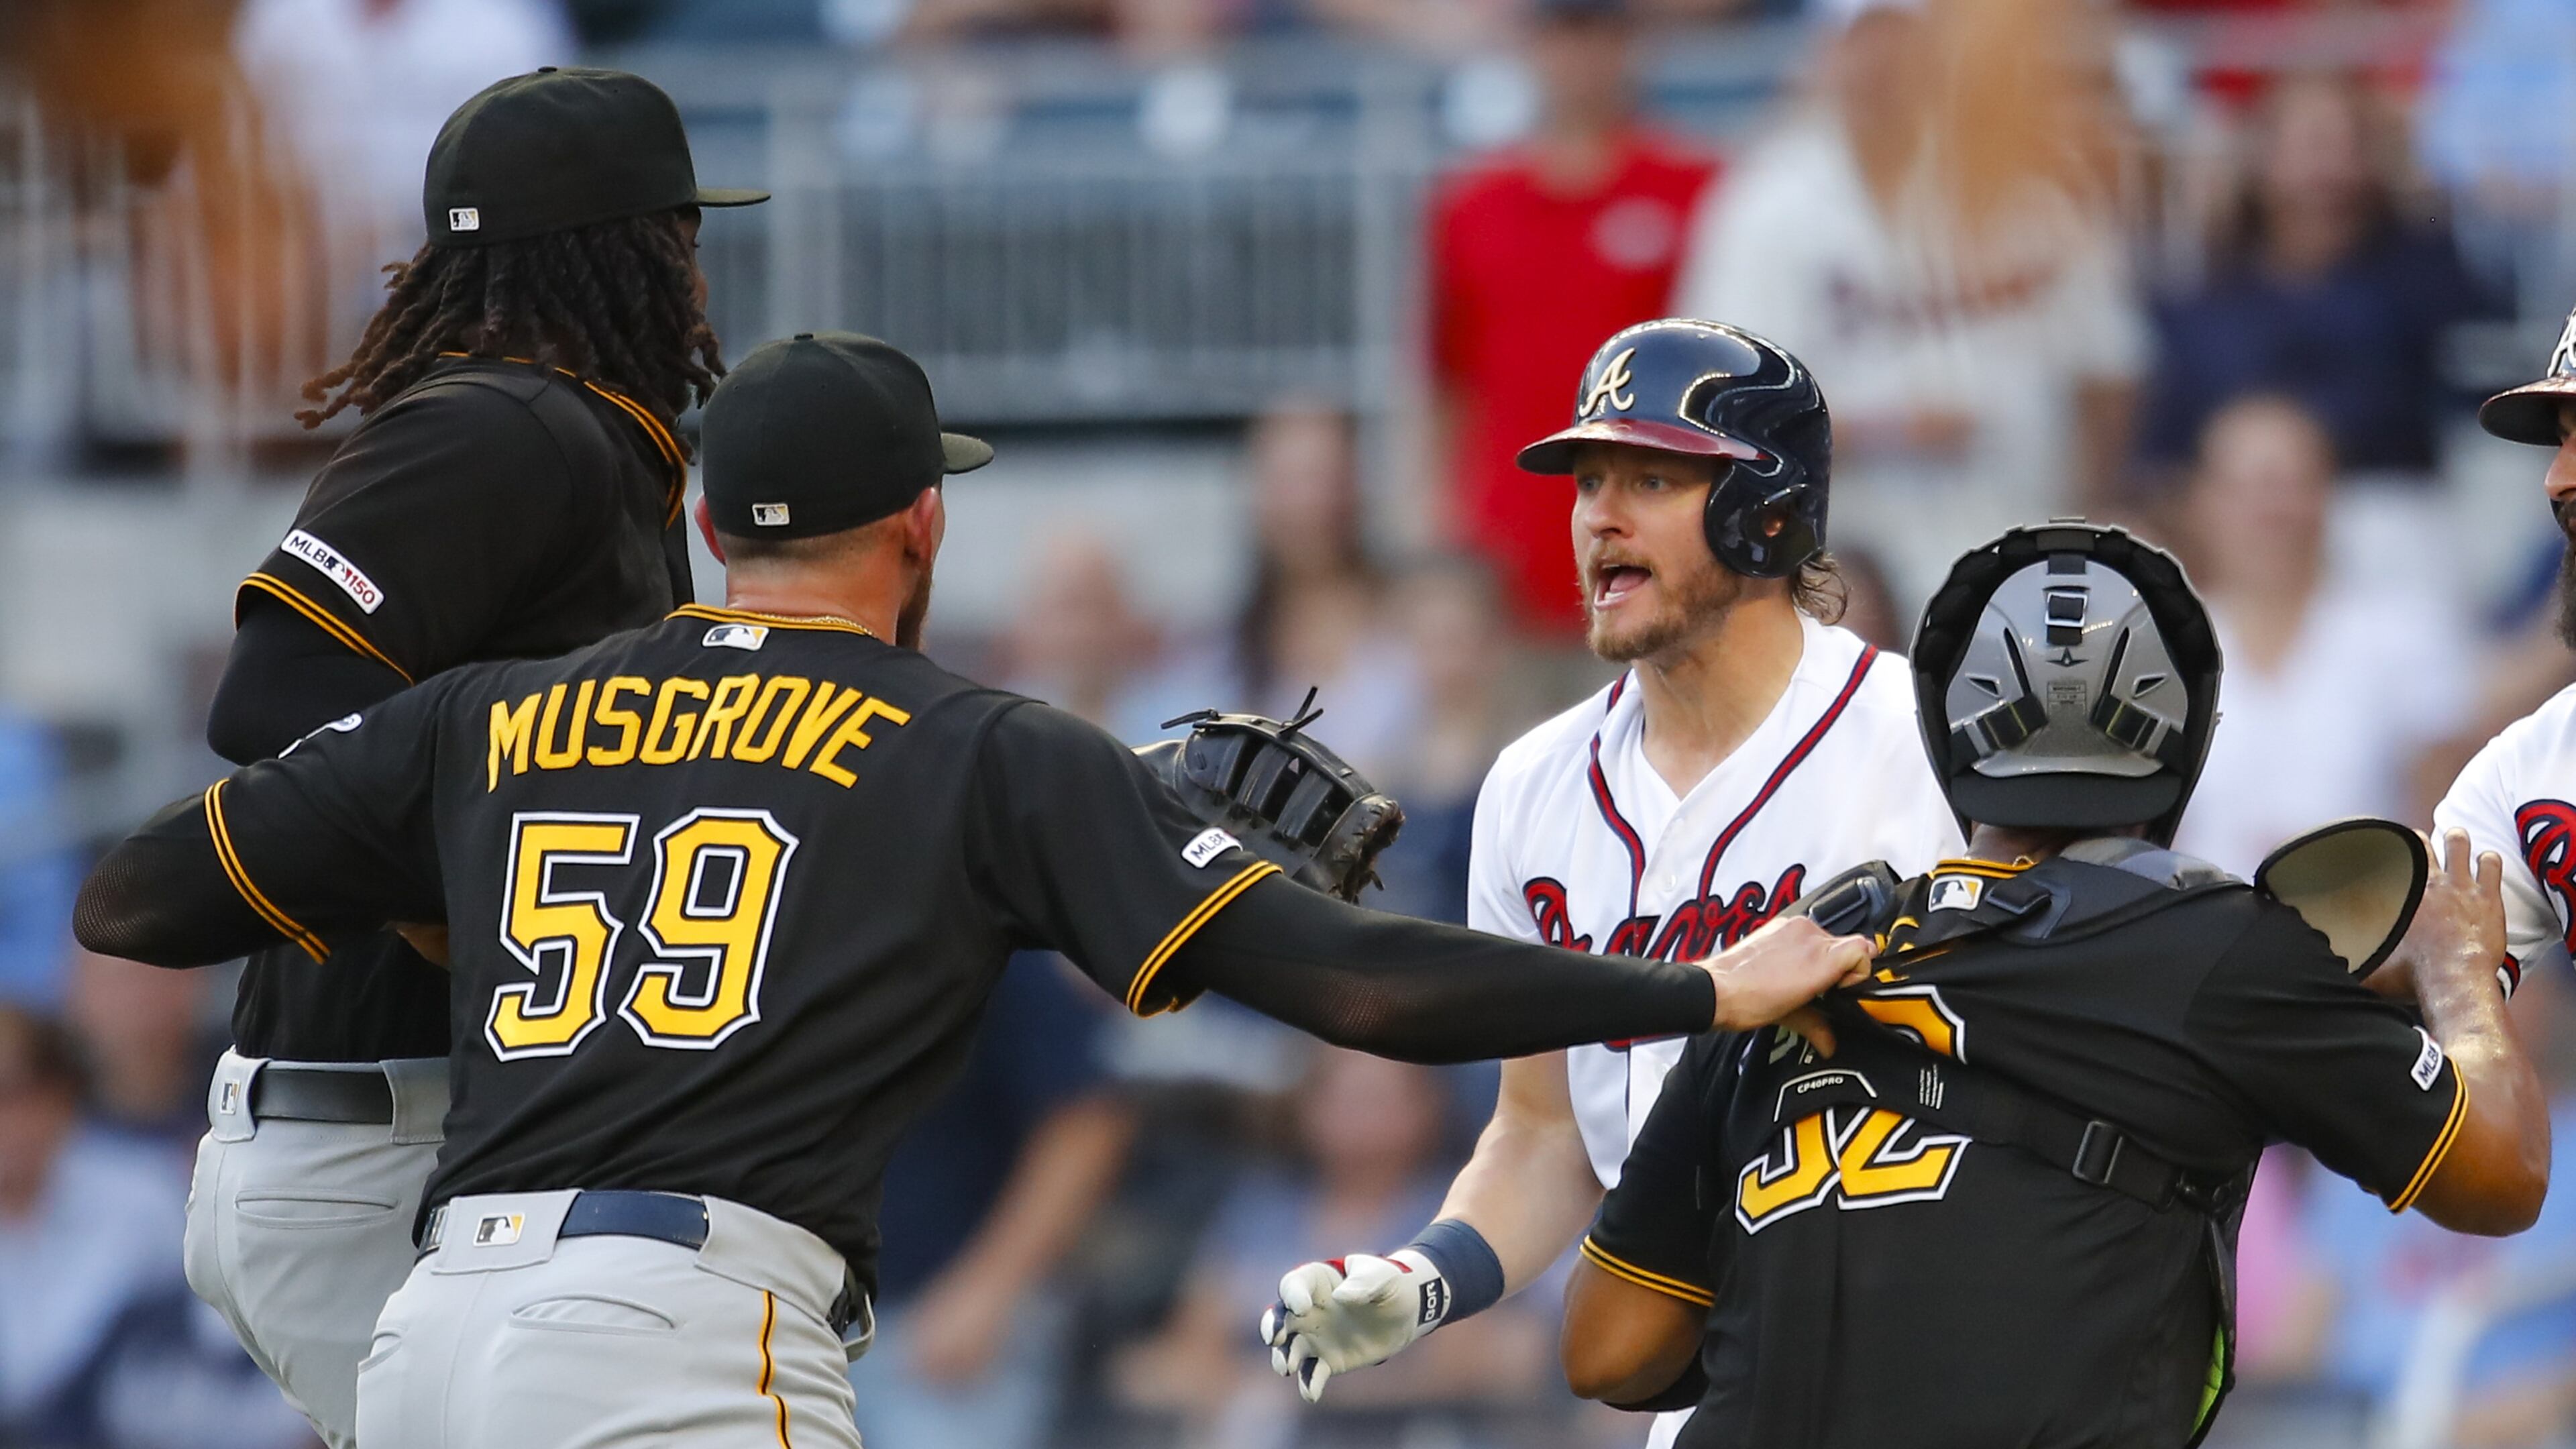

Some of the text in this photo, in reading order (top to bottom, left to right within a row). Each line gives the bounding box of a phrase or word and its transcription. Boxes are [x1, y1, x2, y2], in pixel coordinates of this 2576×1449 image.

[1578, 347, 1635, 417] A
[289, 535, 376, 604] MLB 150
[488, 673, 911, 794] MUSGROVE
[484, 807, 800, 1063] 59
[1797, 1077, 1843, 1093] CP40PRO
